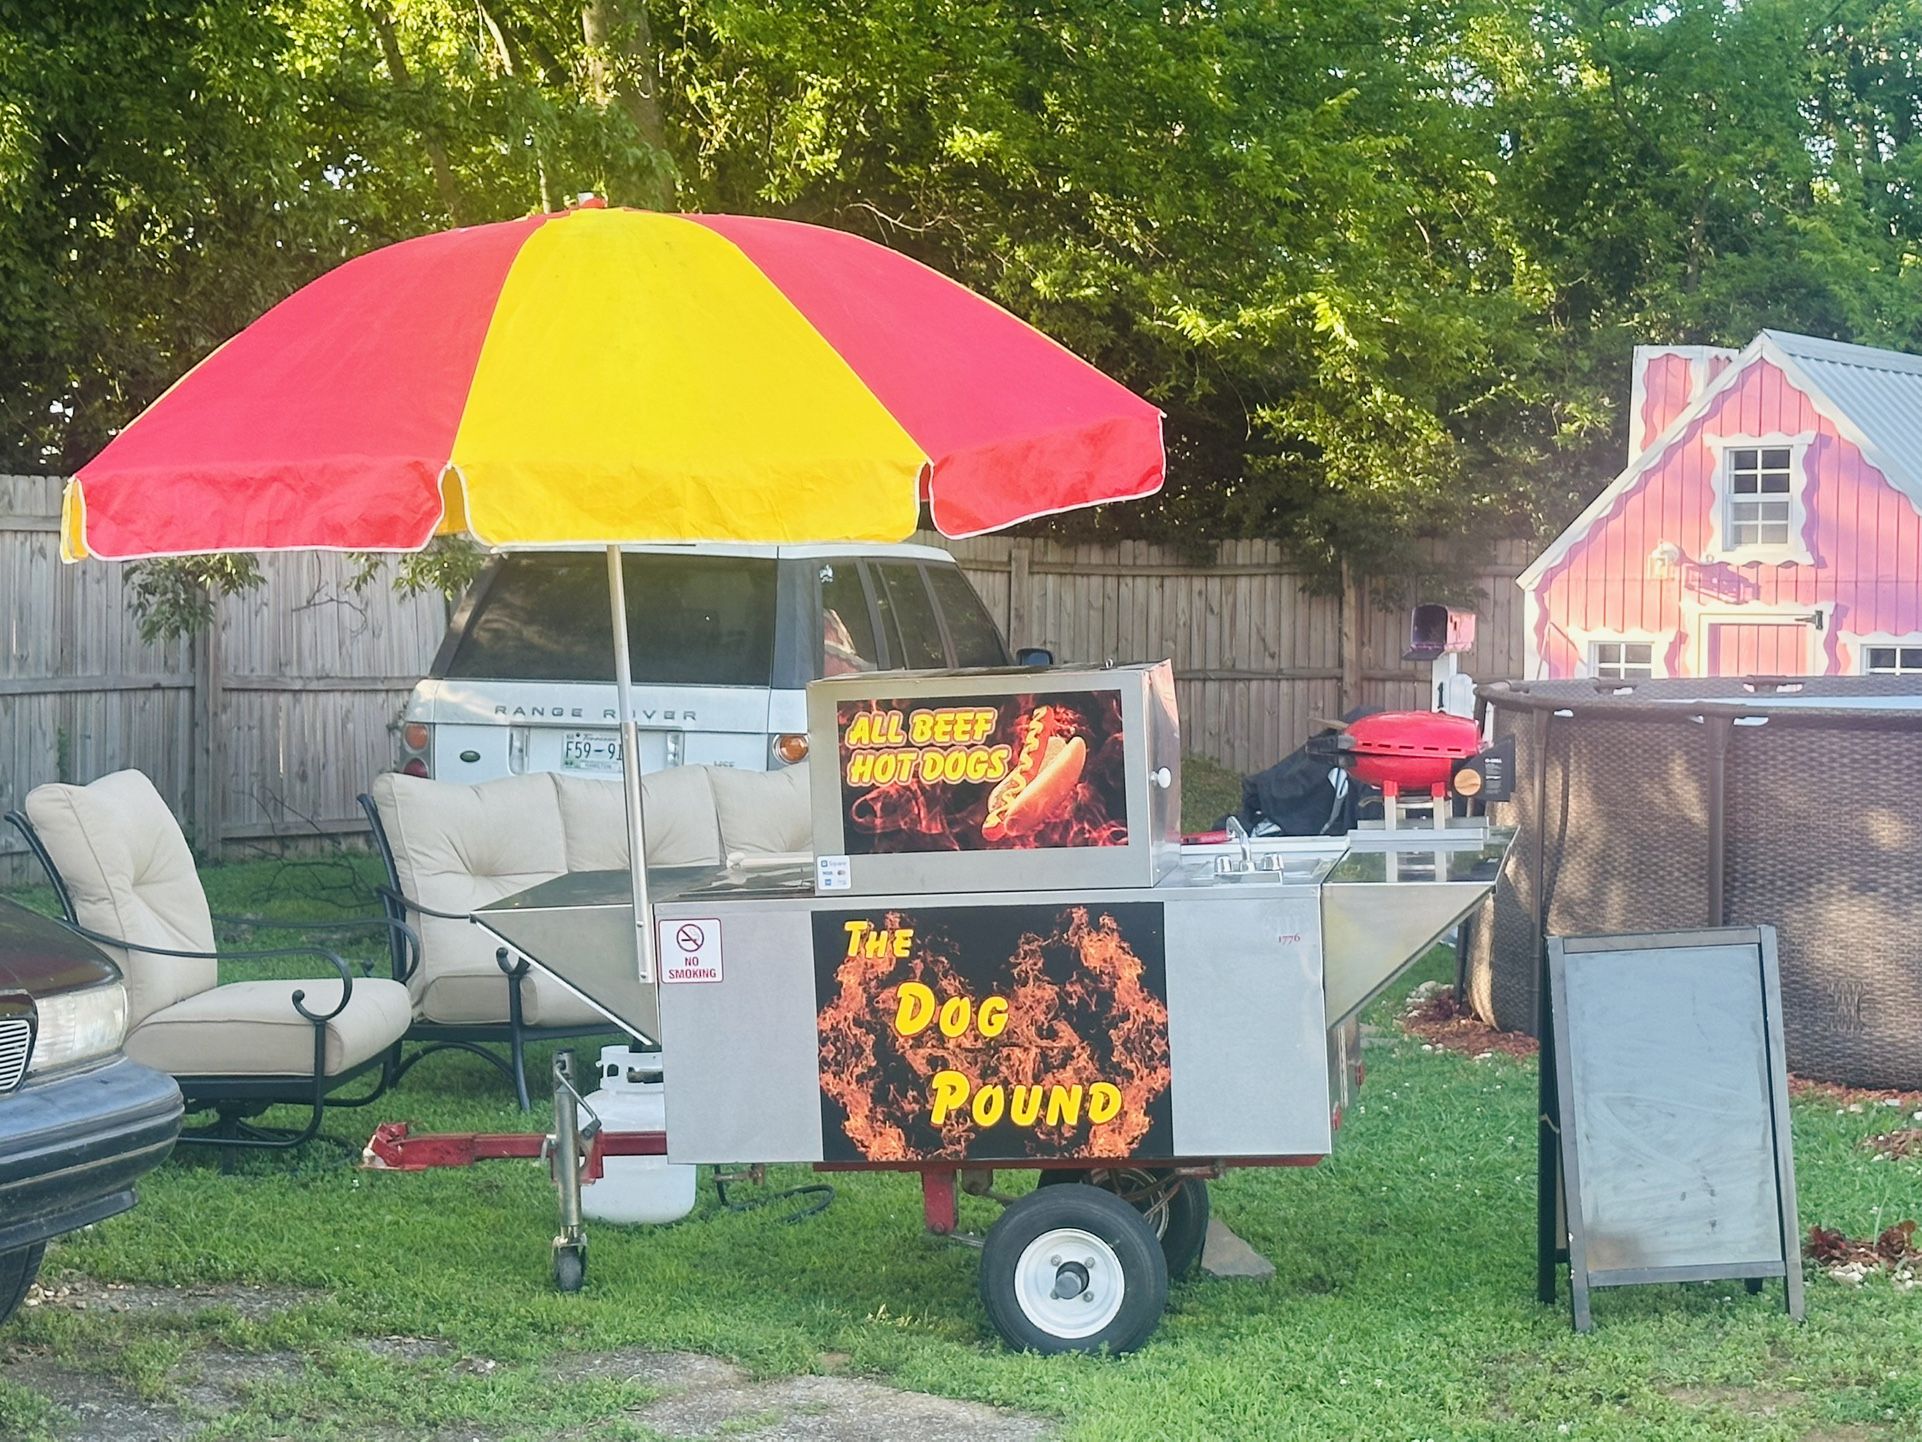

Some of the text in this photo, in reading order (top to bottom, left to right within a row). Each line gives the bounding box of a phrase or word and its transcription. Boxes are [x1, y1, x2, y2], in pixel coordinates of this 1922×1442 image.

[494, 705, 697, 720] RANGE RVER
[847, 710, 995, 746] ALL BEEF
[849, 748, 1010, 785] HOT DOGS
[844, 921, 914, 959] THE
[1278, 933, 1301, 945] 1776
[668, 968, 717, 979] SMOKING
[685, 956, 699, 967] NO
[893, 981, 1010, 1039] DOG
[930, 1070, 1123, 1128] POUND
